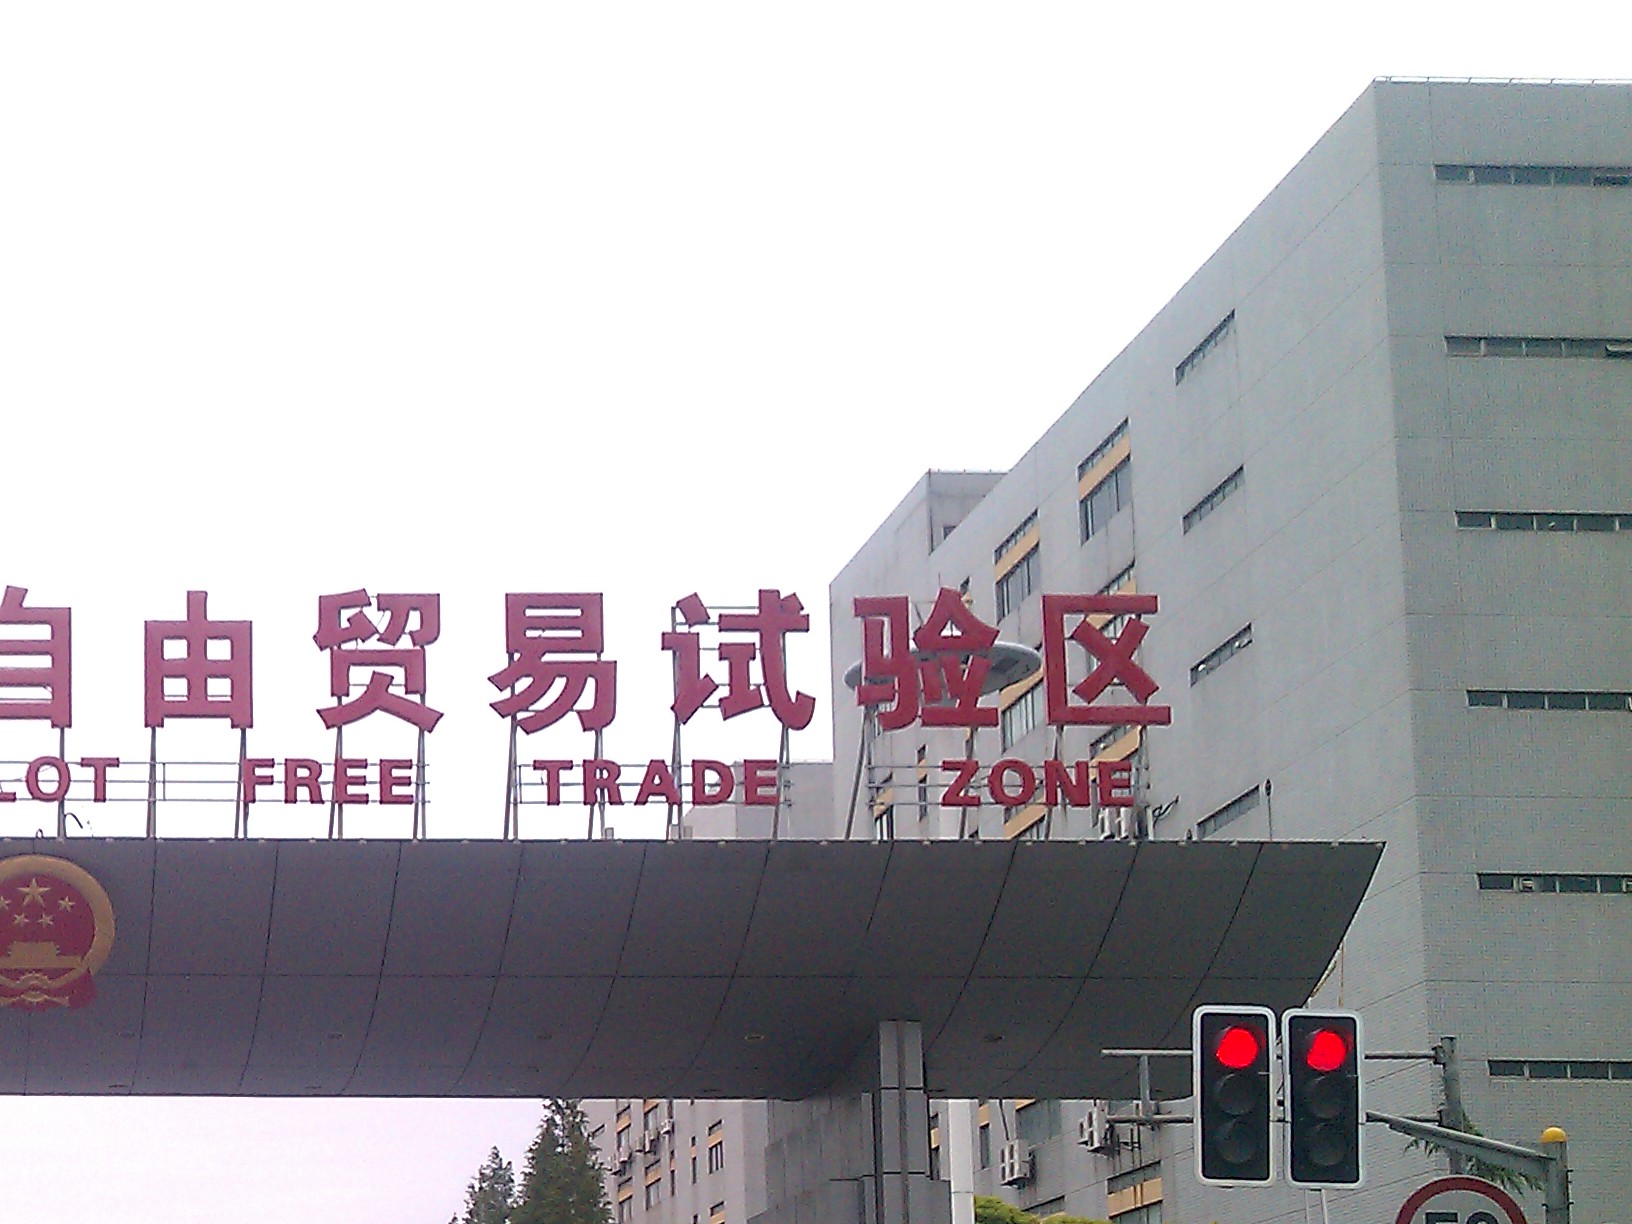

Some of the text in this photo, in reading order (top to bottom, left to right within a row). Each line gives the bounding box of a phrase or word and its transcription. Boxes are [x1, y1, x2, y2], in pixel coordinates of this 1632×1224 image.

[242, 757, 415, 806] FREE
[533, 758, 782, 807] TRADE
[941, 759, 1136, 808] ZONE
